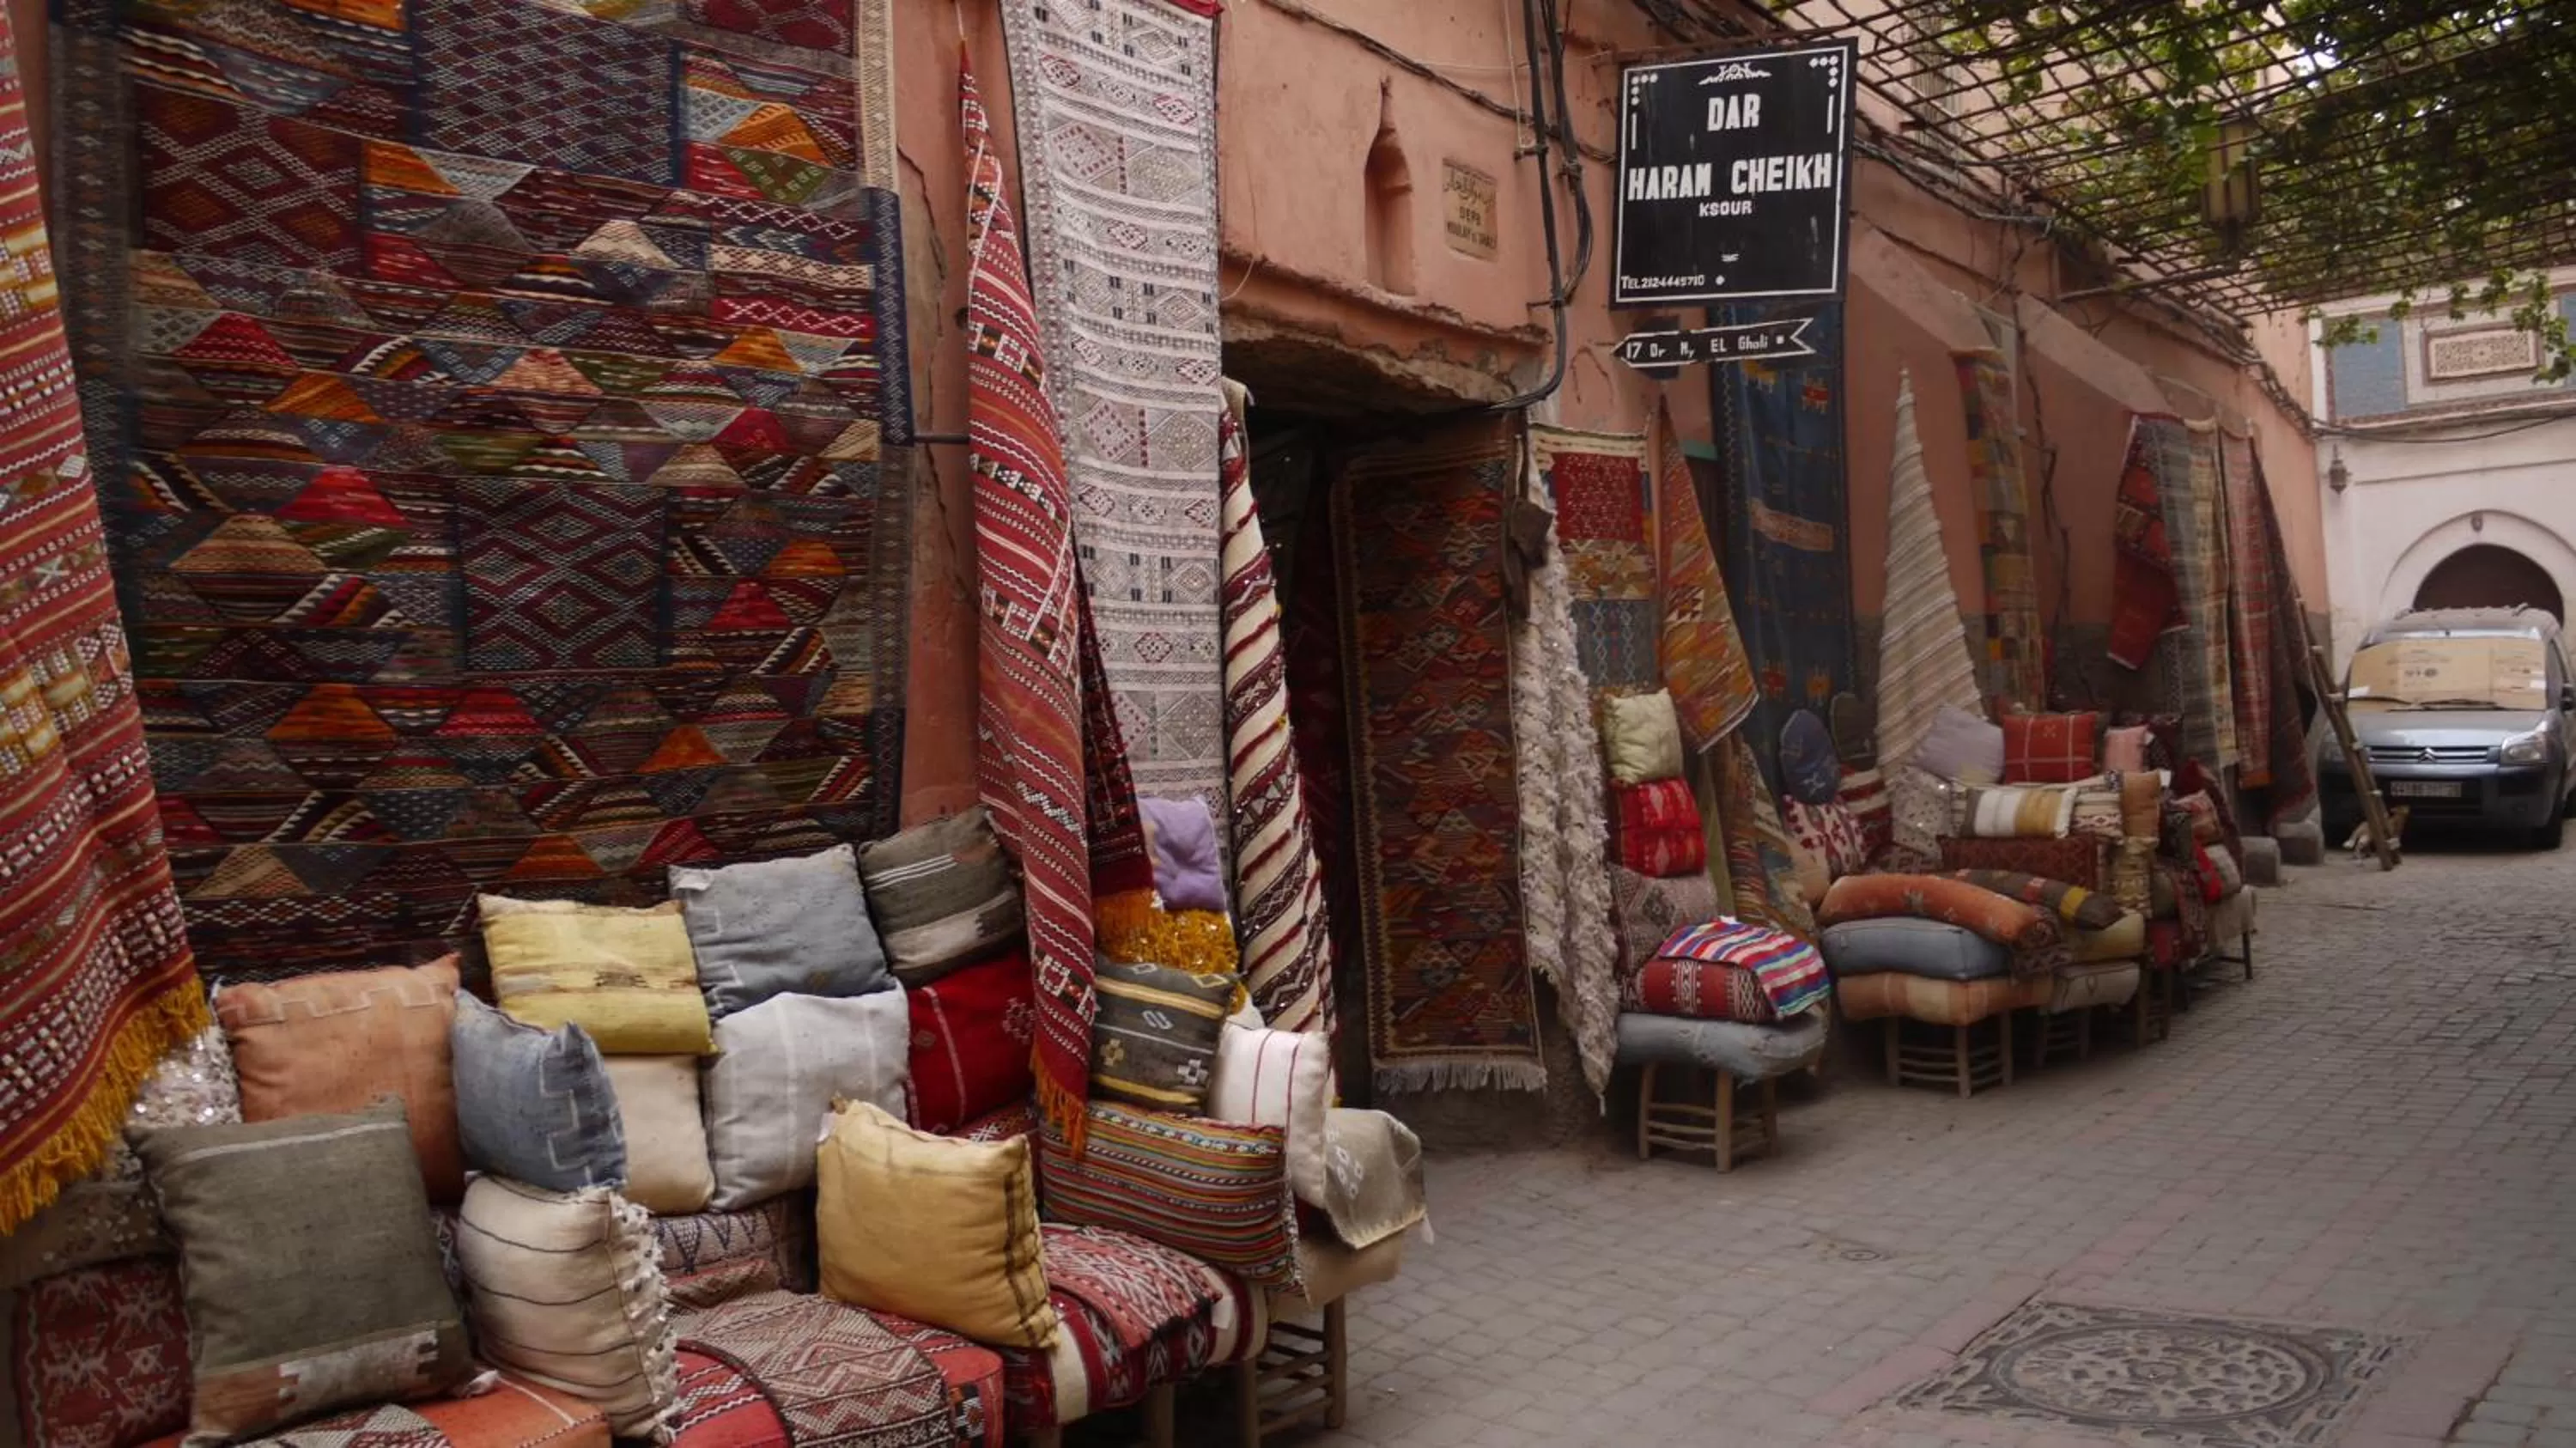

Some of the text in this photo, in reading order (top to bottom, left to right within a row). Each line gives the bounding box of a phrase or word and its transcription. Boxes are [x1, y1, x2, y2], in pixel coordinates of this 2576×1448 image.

[1707, 93, 1761, 131] DAR
[1730, 152, 1832, 194] CHEIKH
[1698, 200, 1753, 217] KSOUR
[1625, 341, 1643, 360] 17
[1710, 338, 1727, 353] EL
